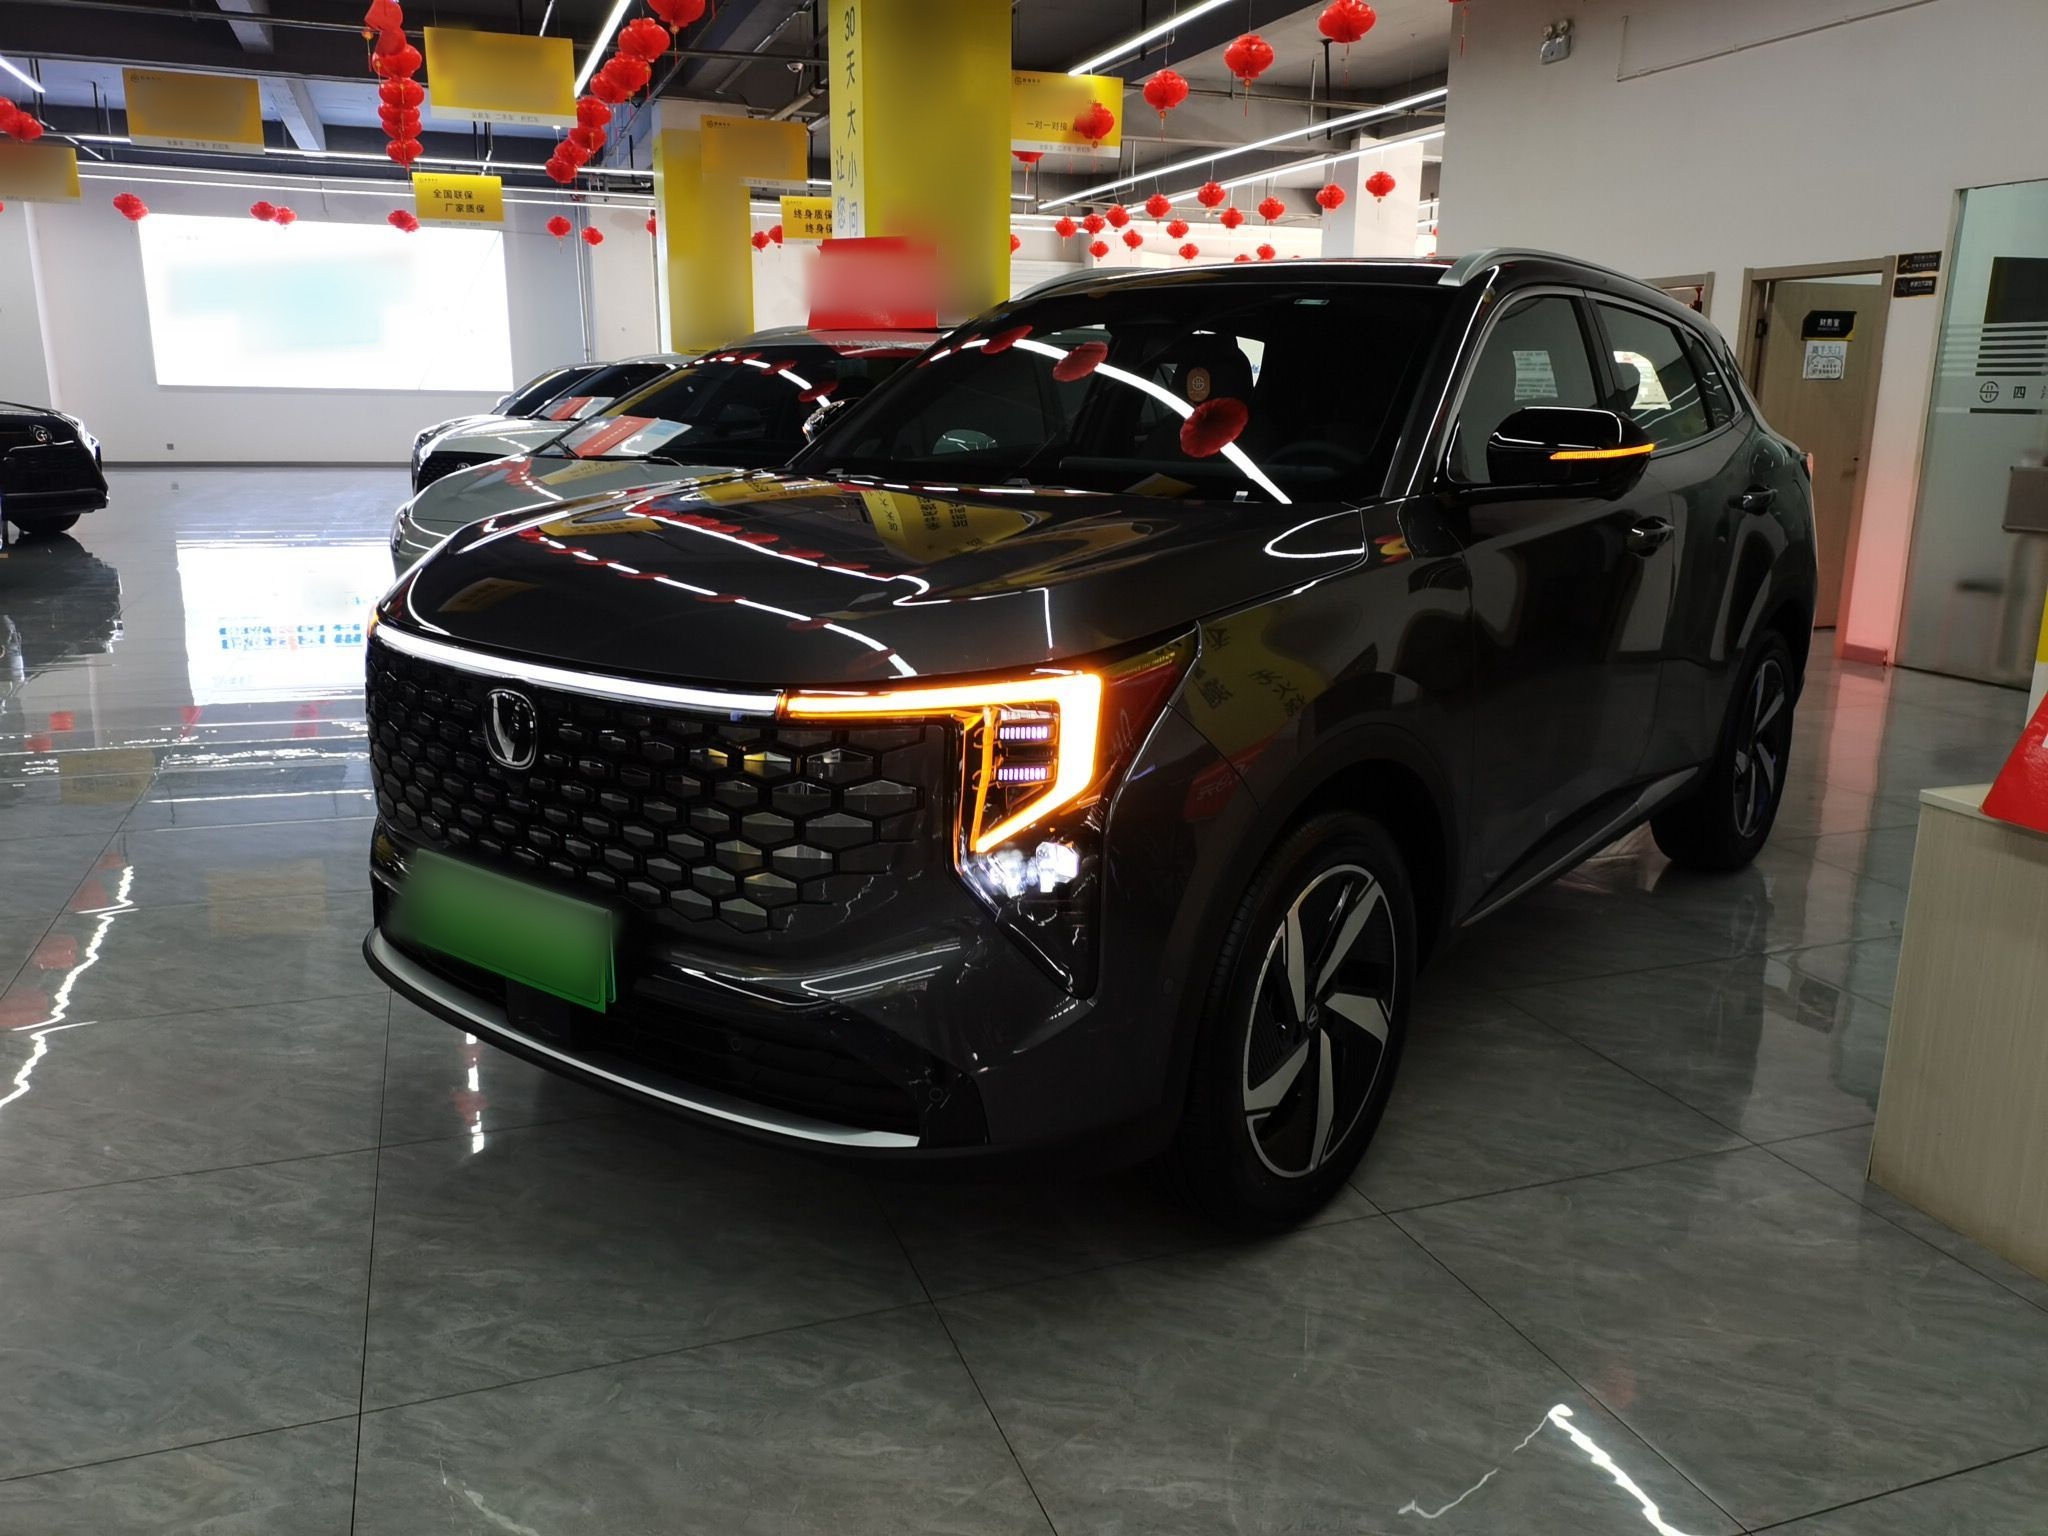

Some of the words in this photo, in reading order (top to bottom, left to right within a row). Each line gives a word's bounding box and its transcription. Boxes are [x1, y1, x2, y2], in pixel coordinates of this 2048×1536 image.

[433, 188, 473, 200] 全国联保
[445, 203, 485, 213] 厂家质保
[794, 208, 833, 220] 终身质保
